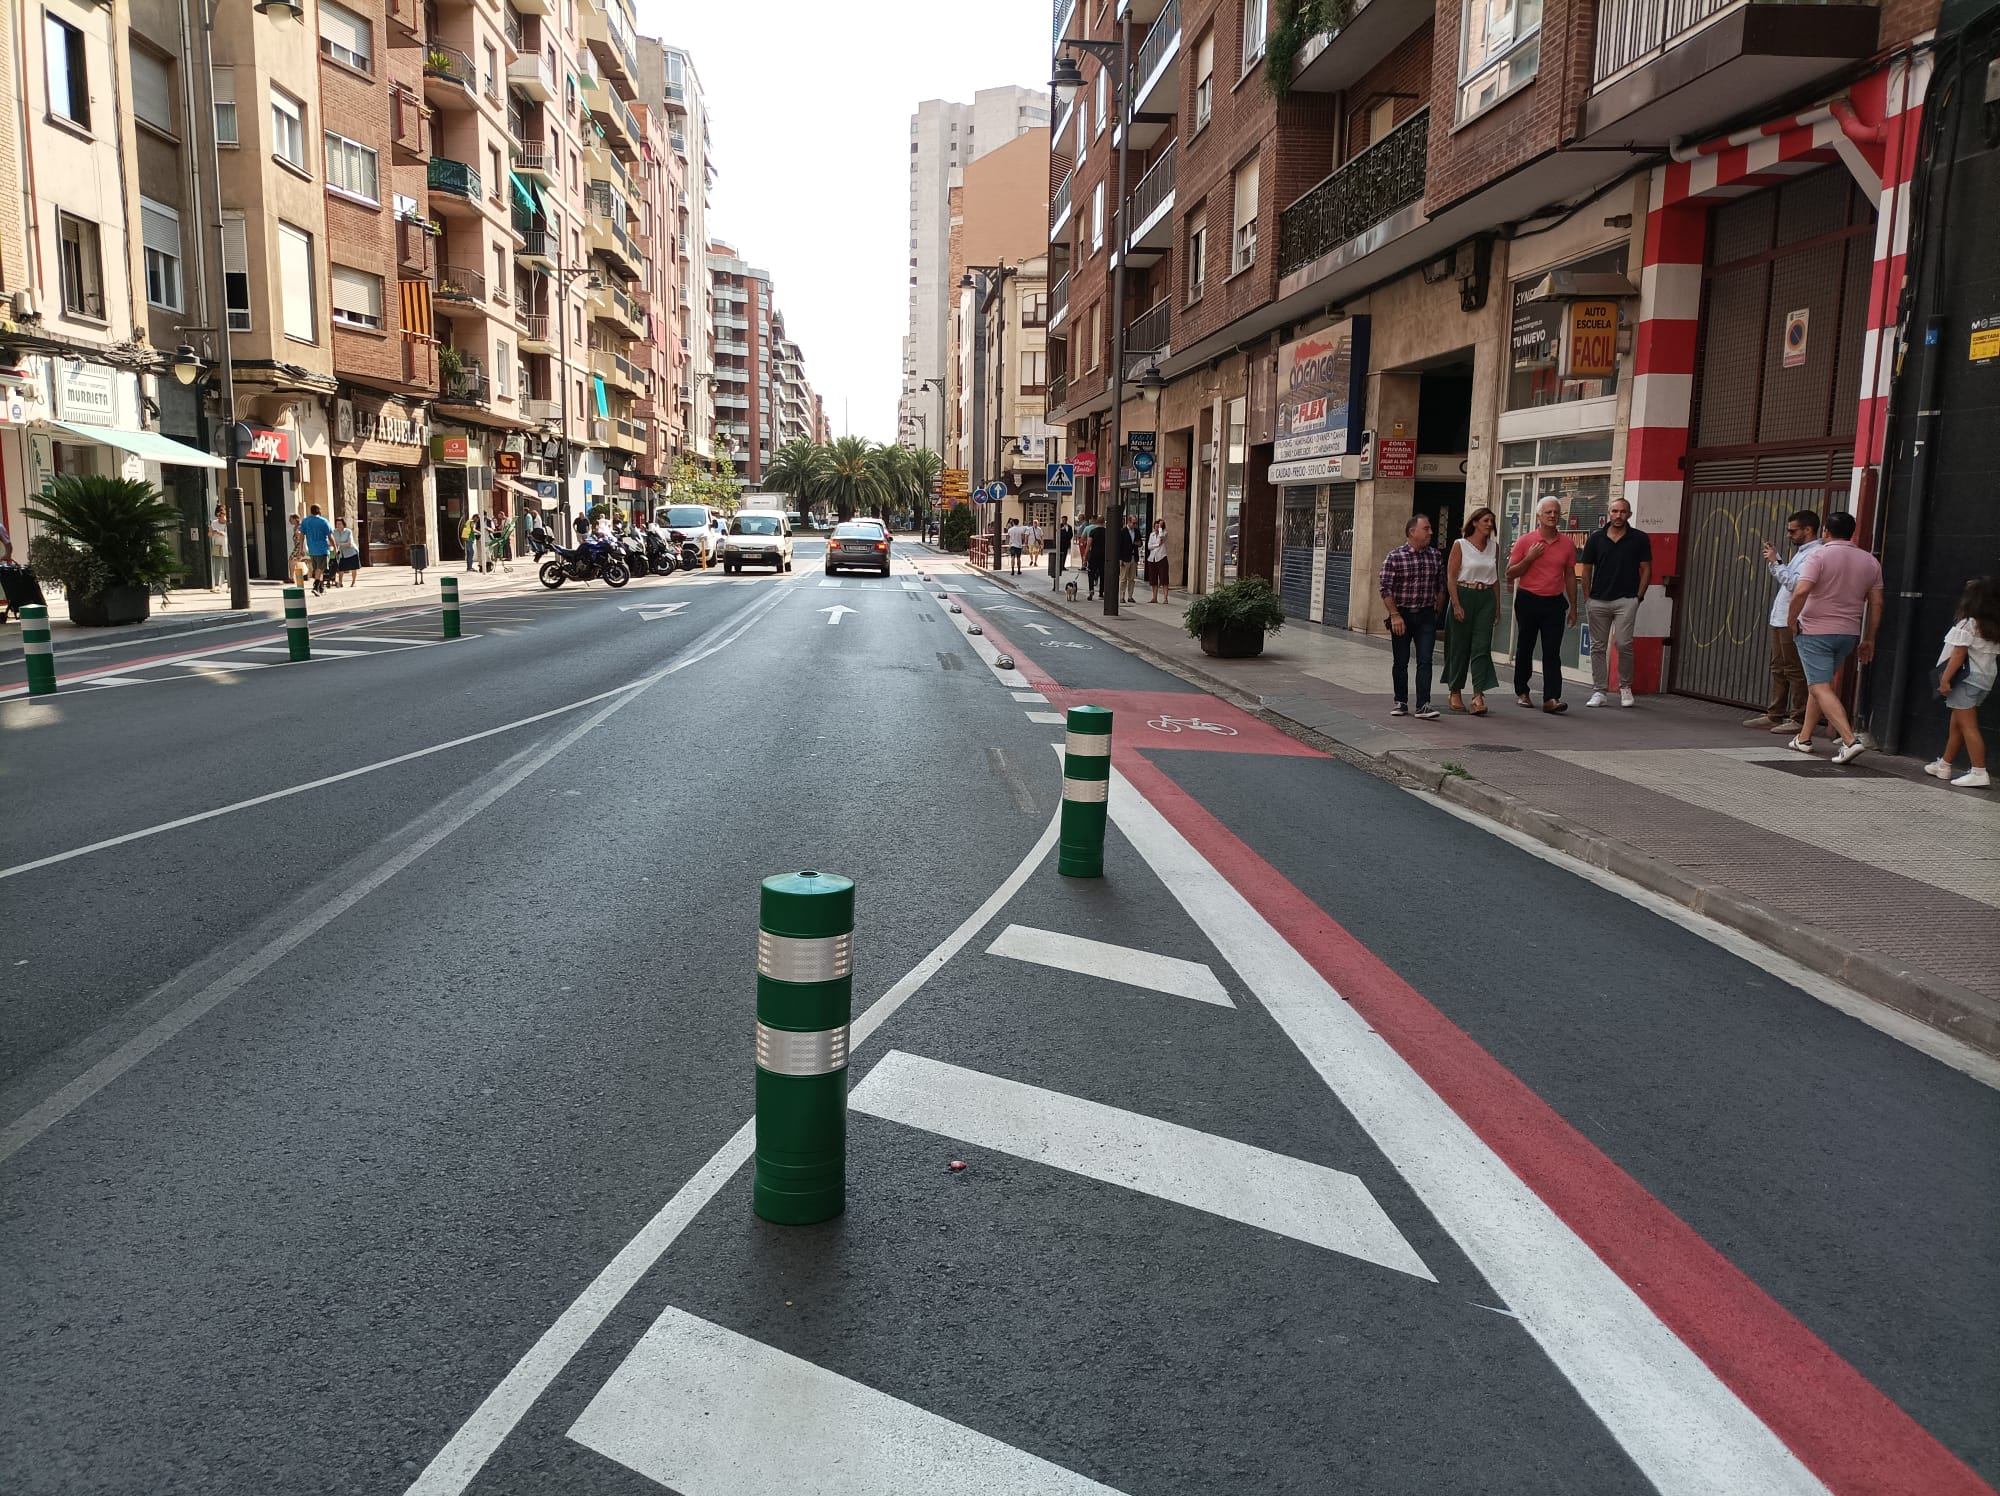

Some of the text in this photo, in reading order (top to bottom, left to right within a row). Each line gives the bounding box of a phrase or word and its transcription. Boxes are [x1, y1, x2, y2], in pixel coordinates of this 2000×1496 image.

[1584, 307, 1606, 318] AUTO
[1576, 319, 1611, 330] ESCUELA
[1513, 329, 1546, 349] TU NUEVO
[1573, 336, 1613, 368] FACIL
[67, 388, 108, 406] MURRIETA
[1298, 399, 1326, 424] FLEX
[356, 410, 375, 441] LA
[378, 415, 421, 446] ABUELA
